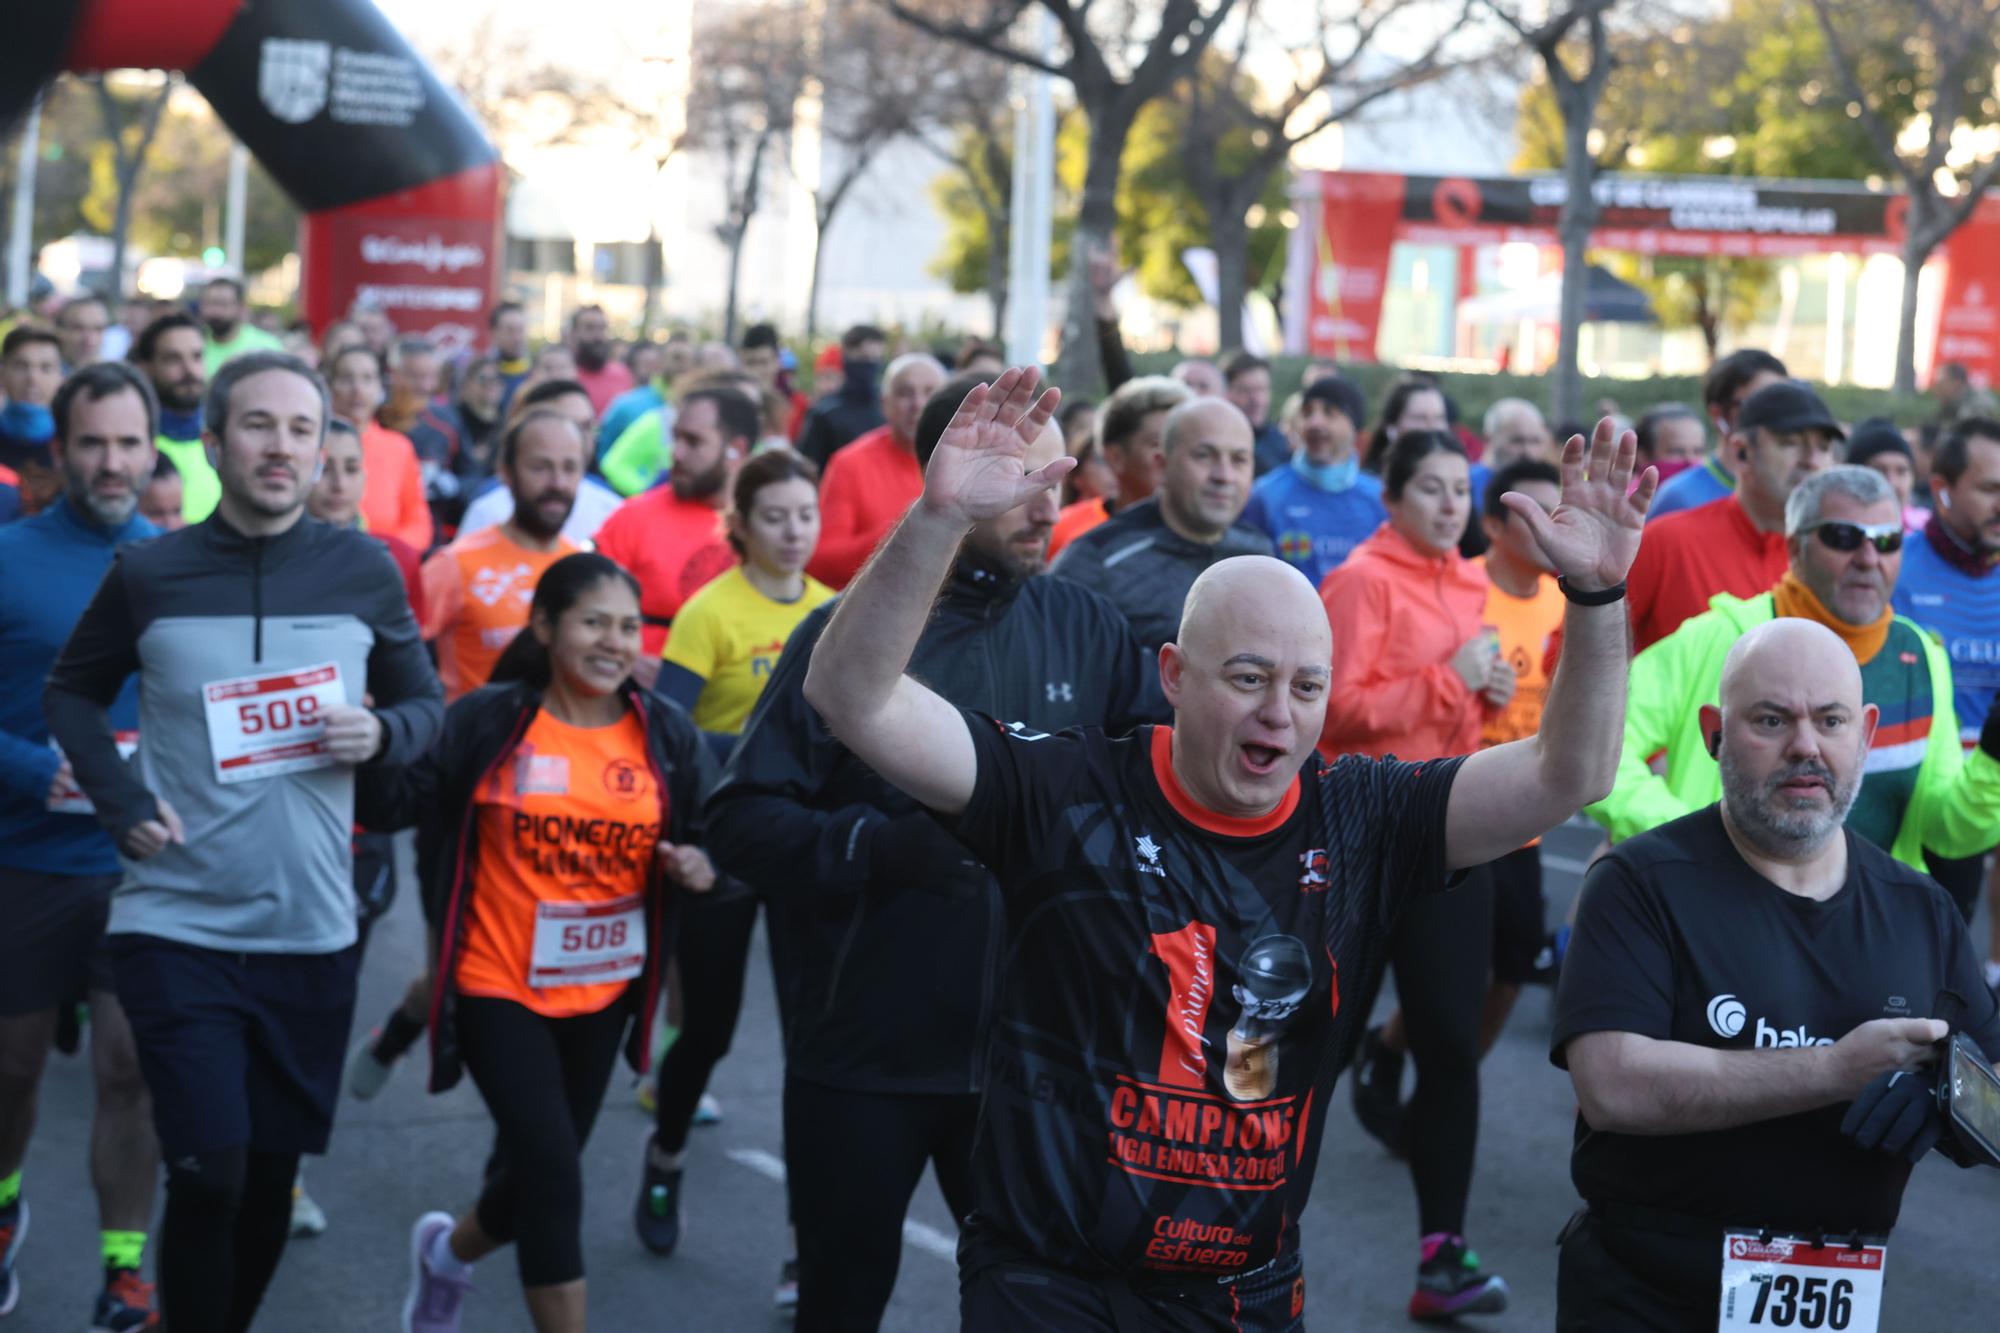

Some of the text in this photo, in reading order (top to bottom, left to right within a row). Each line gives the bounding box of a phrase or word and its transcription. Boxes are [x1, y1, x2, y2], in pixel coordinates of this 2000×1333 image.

[238, 695, 321, 735] 509
[562, 920, 628, 952] 508
[1110, 1086, 1294, 1150] CAMPIONS
[1156, 1146, 1229, 1178] ENDESA
[1154, 1215, 1253, 1245] Cultura del
[1145, 1238, 1249, 1265] Esfuerzo
[1749, 1273, 1854, 1331] 7356
